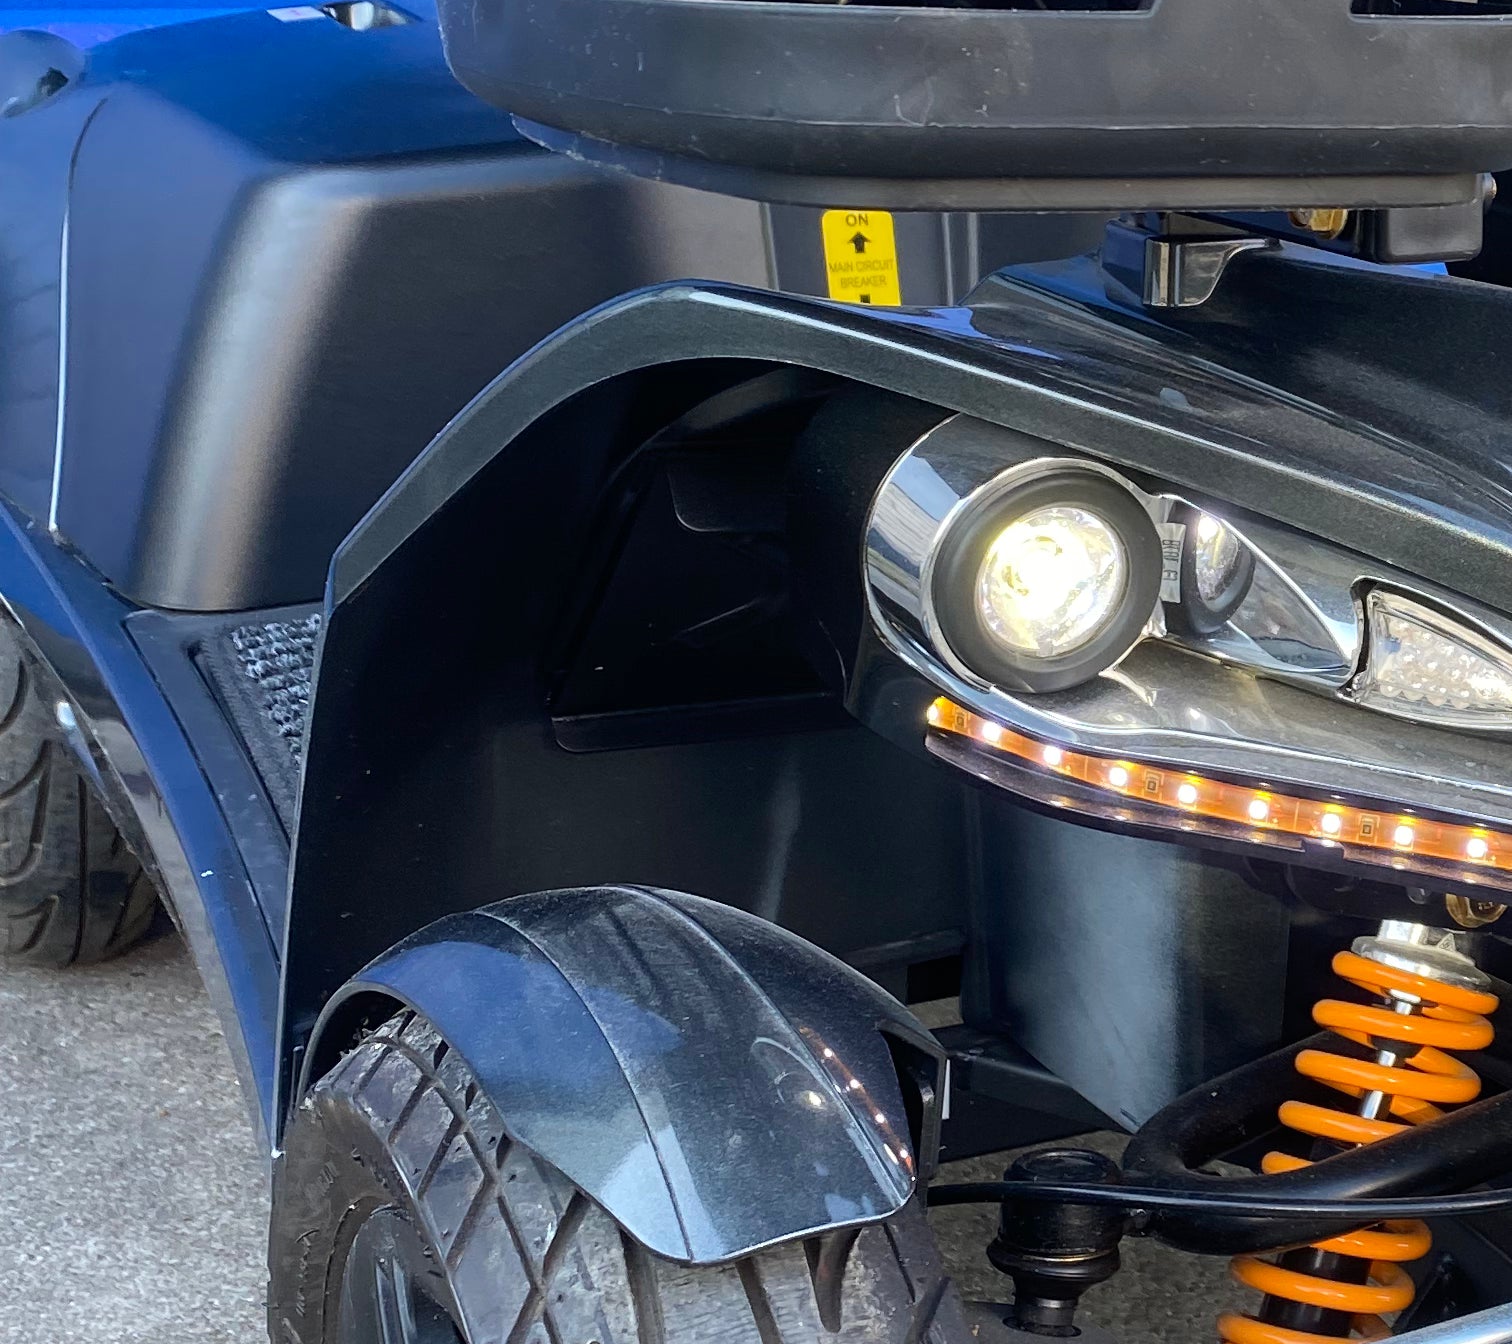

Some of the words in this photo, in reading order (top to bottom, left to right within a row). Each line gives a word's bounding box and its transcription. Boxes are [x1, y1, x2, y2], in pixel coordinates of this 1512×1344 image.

[845, 213, 869, 227] ON
[828, 261, 854, 273] MAIN
[855, 258, 894, 272] CIRCUIT
[840, 275, 887, 288] BREAKER
